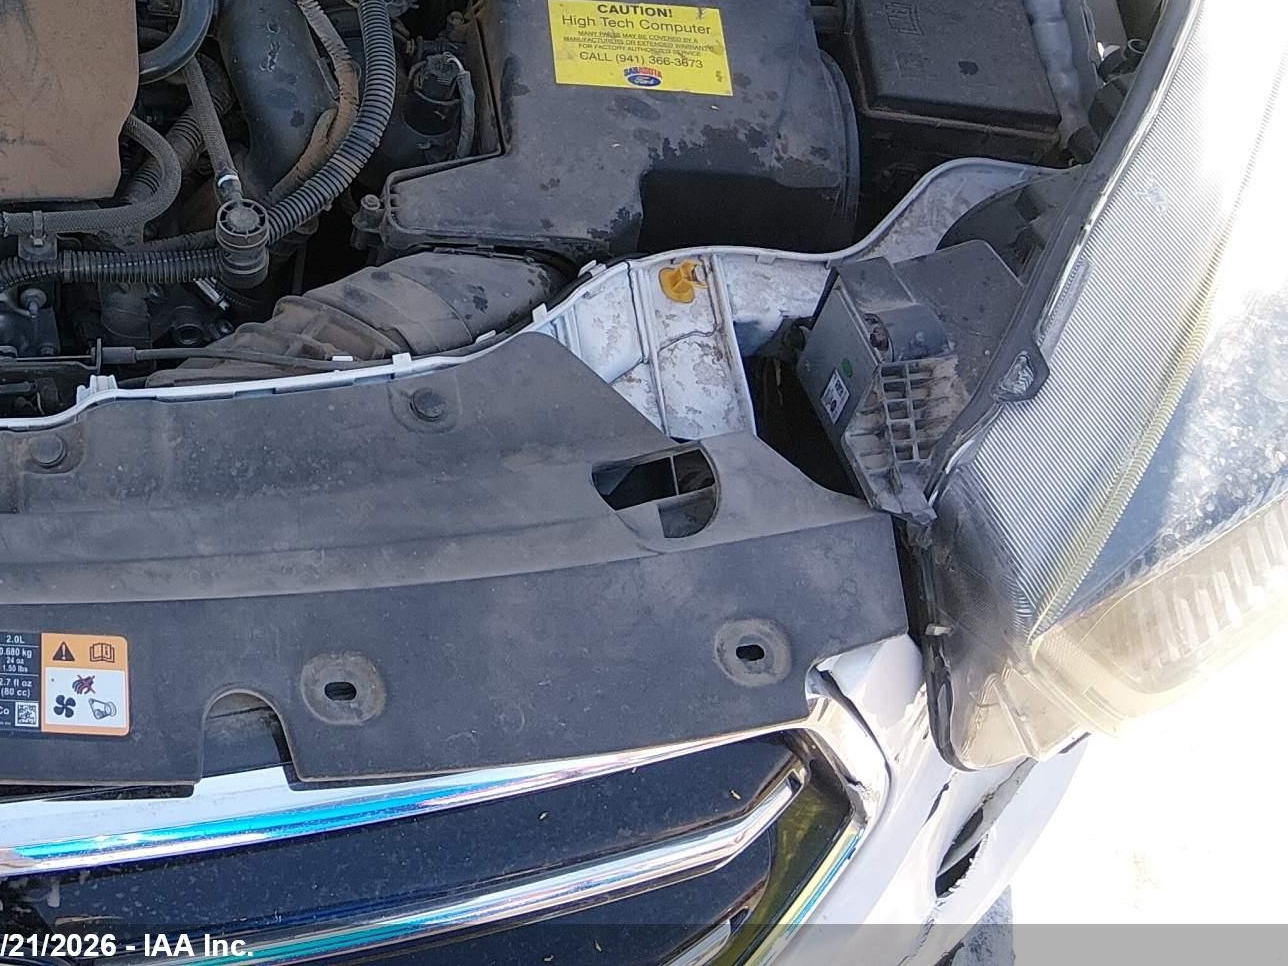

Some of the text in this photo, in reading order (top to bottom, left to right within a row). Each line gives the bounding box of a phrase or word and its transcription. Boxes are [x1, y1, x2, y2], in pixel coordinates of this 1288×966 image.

[597, 3, 673, 18] CAUTION!
[562, 15, 712, 35] High Tech Computer
[637, 40, 673, 48] EXTENDED
[649, 35, 681, 43] COVERED
[579, 51, 612, 62] CALL
[615, 53, 645, 65] (941)
[6, 635, 25, 644] 2.0L
[21, 648, 32, 659] kg
[2, 664, 28, 673] 1.50 lbs
[12, 678, 20, 686] fl
[0, 687, 31, 698] (80 cc)
